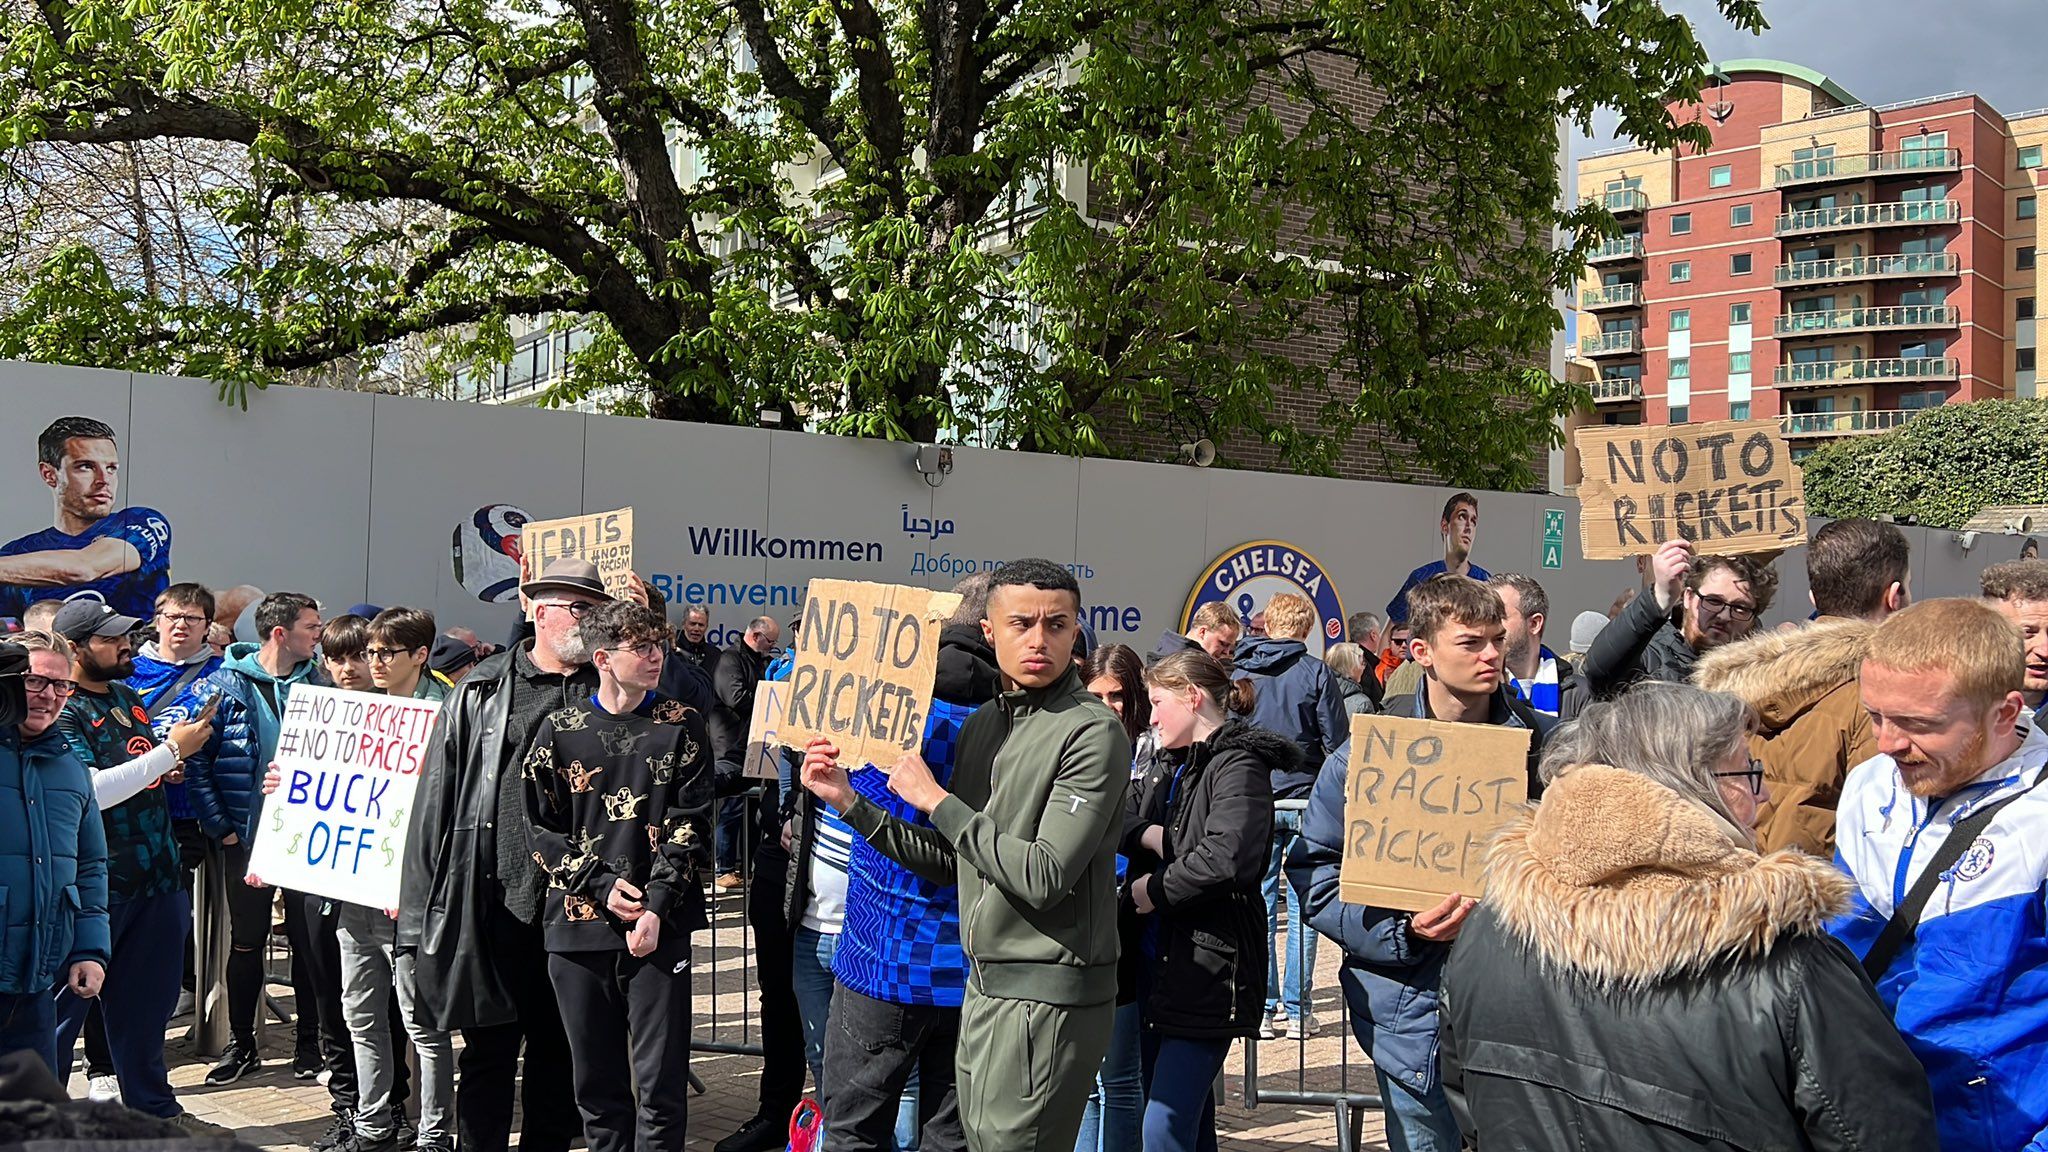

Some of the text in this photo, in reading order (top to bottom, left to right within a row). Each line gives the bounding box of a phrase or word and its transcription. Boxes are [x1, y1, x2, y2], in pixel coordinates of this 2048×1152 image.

[1614, 479, 1801, 547] RICKETTS
[688, 526, 883, 562] Willkommen
[910, 552, 977, 578] Добро
[1545, 546, 1558, 566] A
[1215, 549, 1323, 599] CHELSEA
[801, 597, 921, 669] NO TO
[343, 700, 364, 726] TO
[364, 703, 438, 744] RICKETT
[334, 730, 356, 763] TO
[1363, 724, 1443, 766] NO
[287, 770, 390, 820] BUCK
[307, 821, 375, 874] OFF
